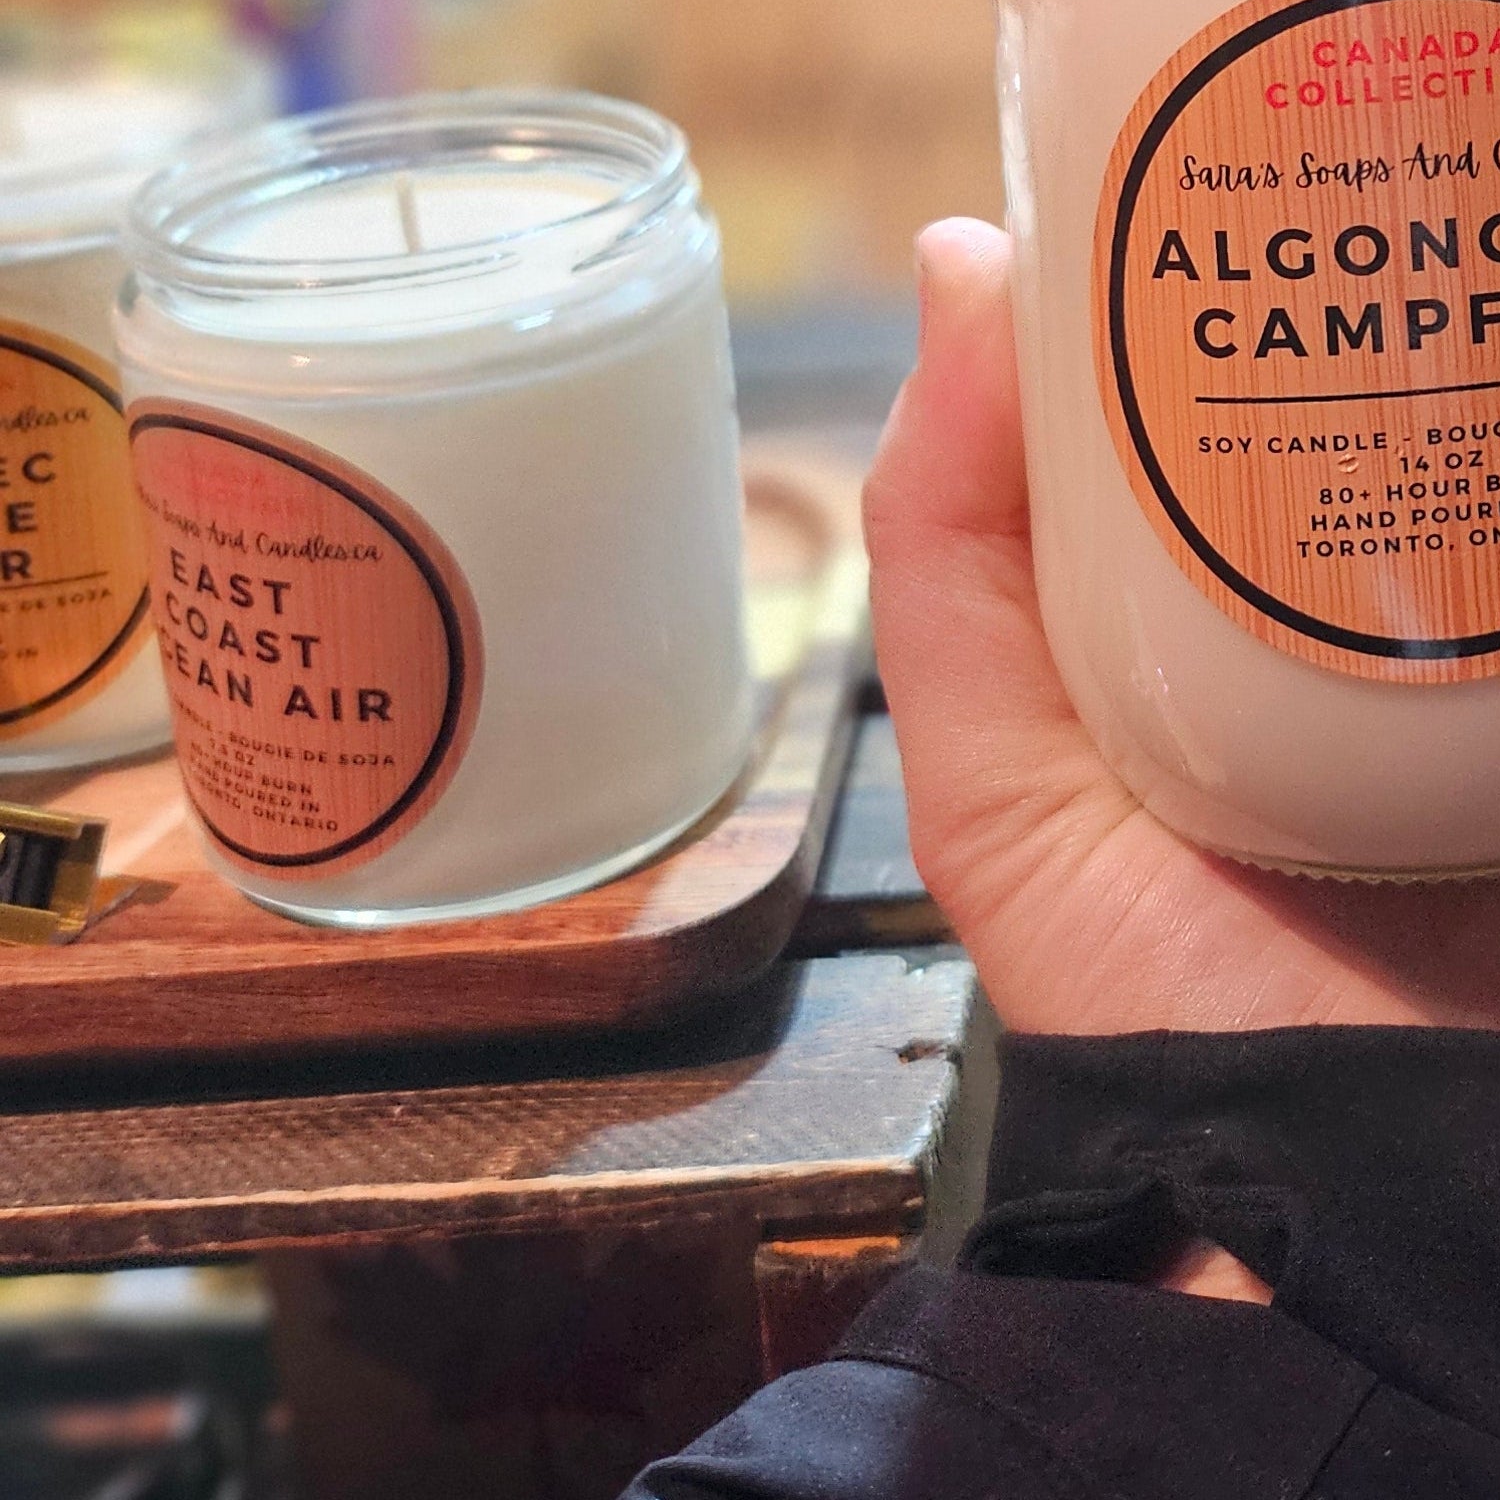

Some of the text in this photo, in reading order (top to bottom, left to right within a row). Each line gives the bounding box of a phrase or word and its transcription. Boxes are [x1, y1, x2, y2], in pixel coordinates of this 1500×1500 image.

[1179, 155, 1284, 192] Sara's
[1296, 151, 1395, 193] Soaps
[1401, 140, 1481, 182] And
[1198, 435, 1253, 454] SOY
[1267, 432, 1389, 453] CANDLE
[1400, 450, 1484, 474] 14 OZ
[1319, 486, 1372, 505] 80+
[1386, 477, 1472, 501] HOUR
[1311, 509, 1397, 532] HAND
[1297, 532, 1455, 558] TORONTO,
[170, 546, 292, 615] EAST
[166, 590, 320, 668] COAST
[283, 684, 393, 722] AIR
[304, 750, 328, 764] DE
[338, 754, 395, 767] SOJA
